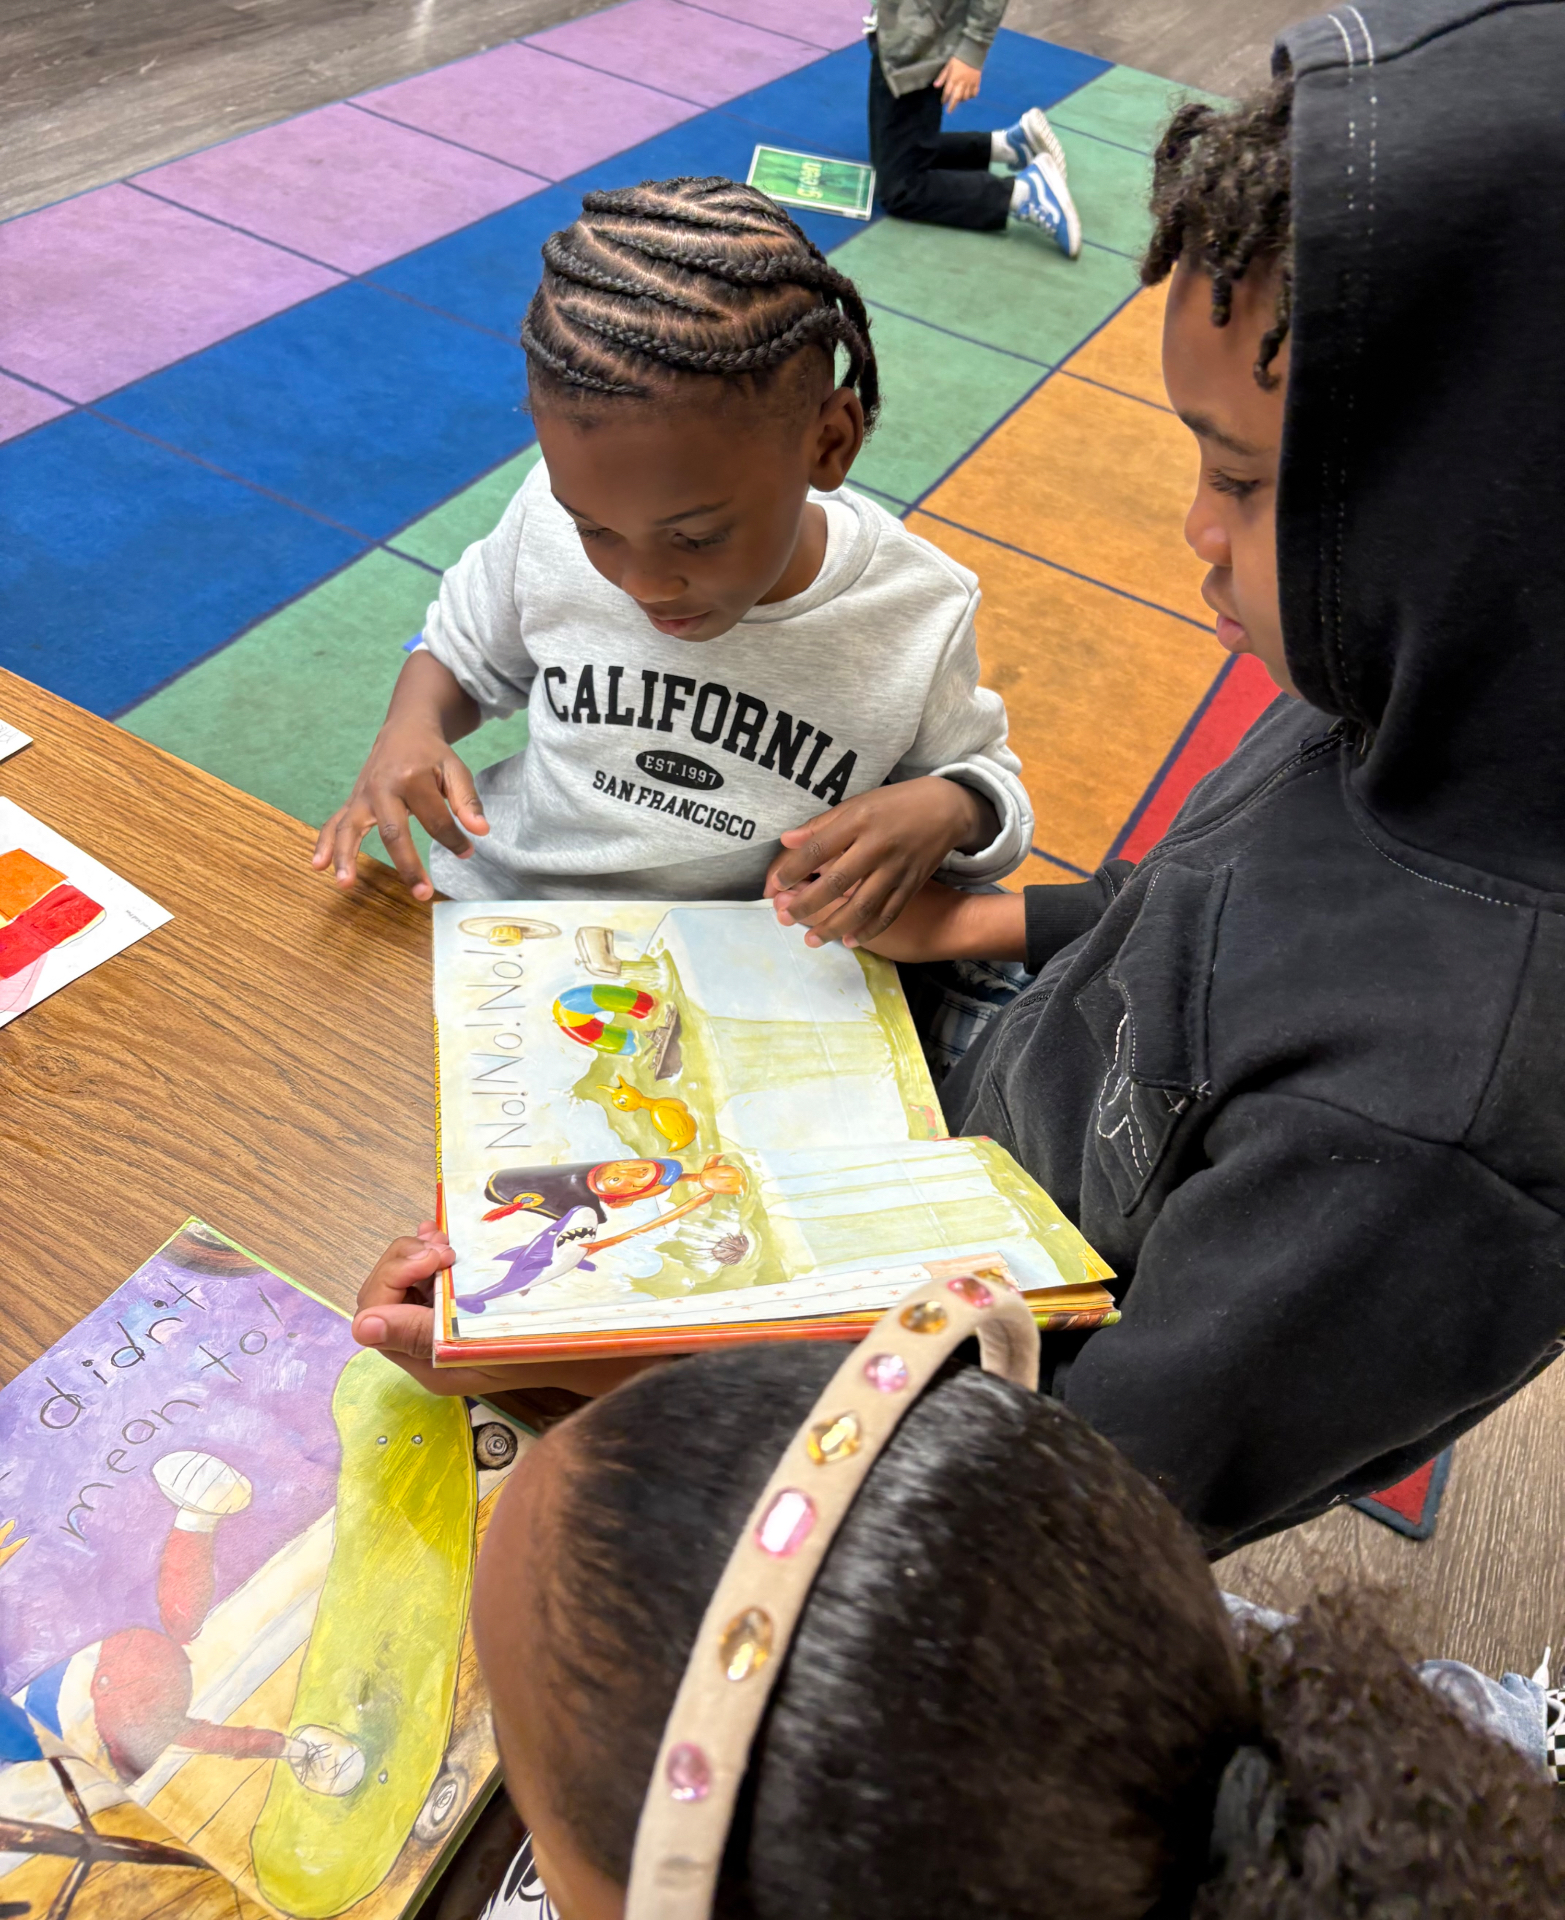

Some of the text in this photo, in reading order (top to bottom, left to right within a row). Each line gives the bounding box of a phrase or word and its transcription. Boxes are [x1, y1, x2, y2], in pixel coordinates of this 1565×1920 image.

[544, 664, 857, 807] CALIFORNIA
[592, 770, 756, 841] SAN FRANCISCO
[643, 755, 718, 787] EST.1997
[463, 949, 532, 1149] No! No! No!
[40, 1278, 207, 1430] didn't
[59, 1286, 298, 1543] mean to!
